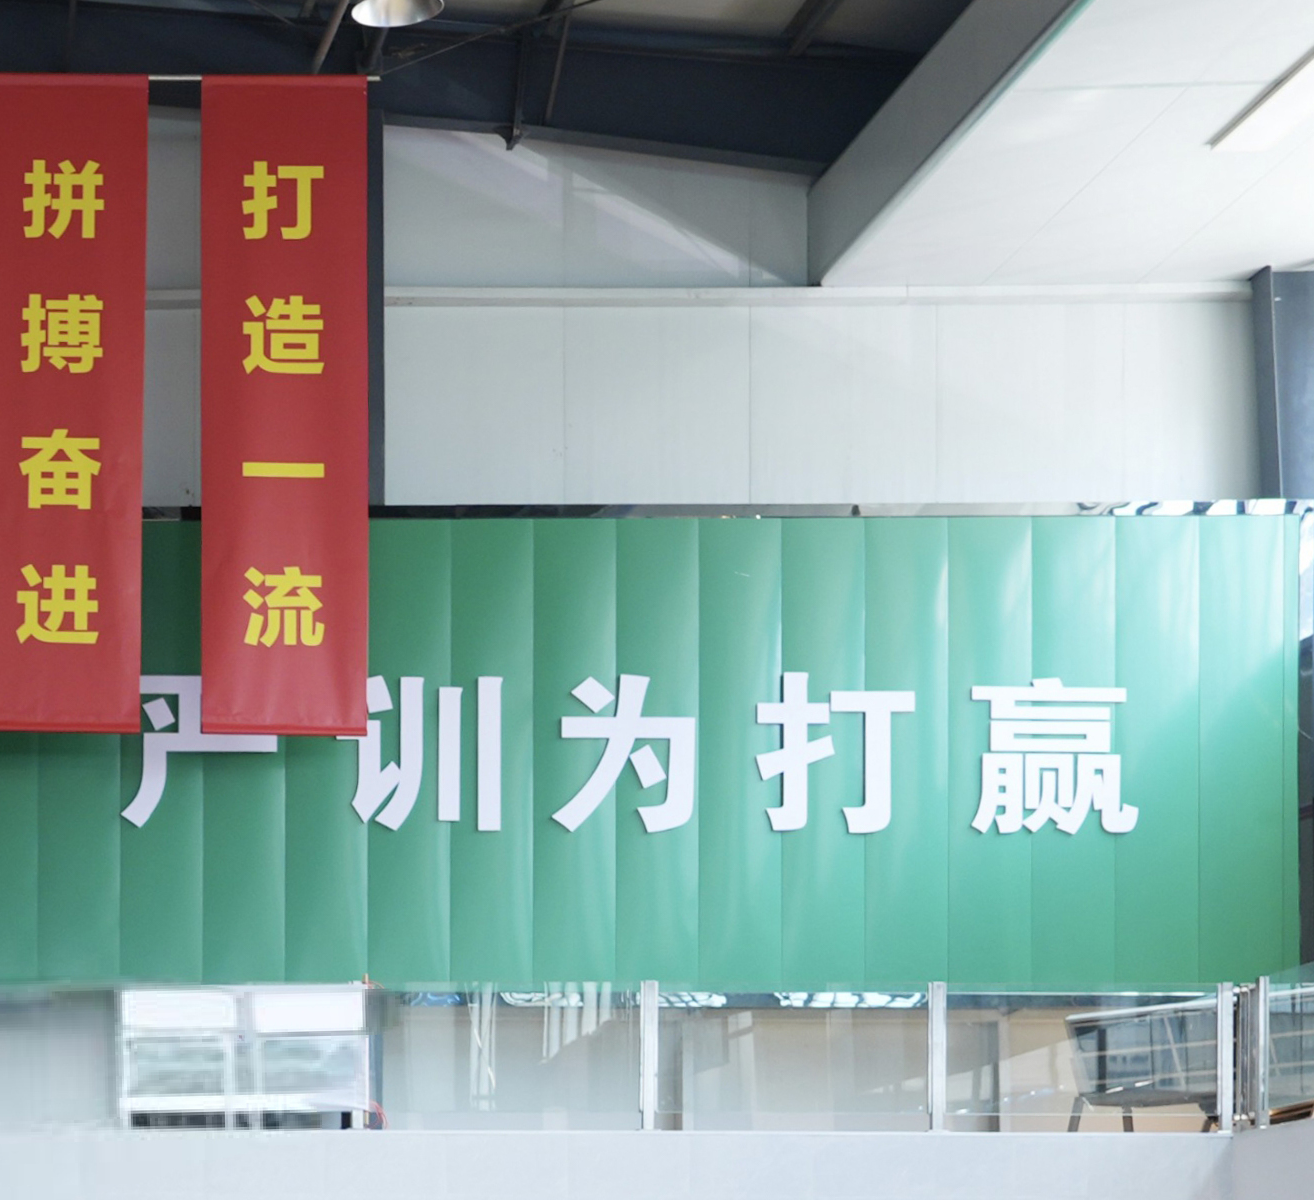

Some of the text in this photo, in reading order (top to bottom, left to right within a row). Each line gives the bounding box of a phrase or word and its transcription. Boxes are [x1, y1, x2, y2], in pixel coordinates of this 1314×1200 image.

[15, 158, 106, 646] 拼搏奋进
[240, 160, 326, 649] 打造一流
